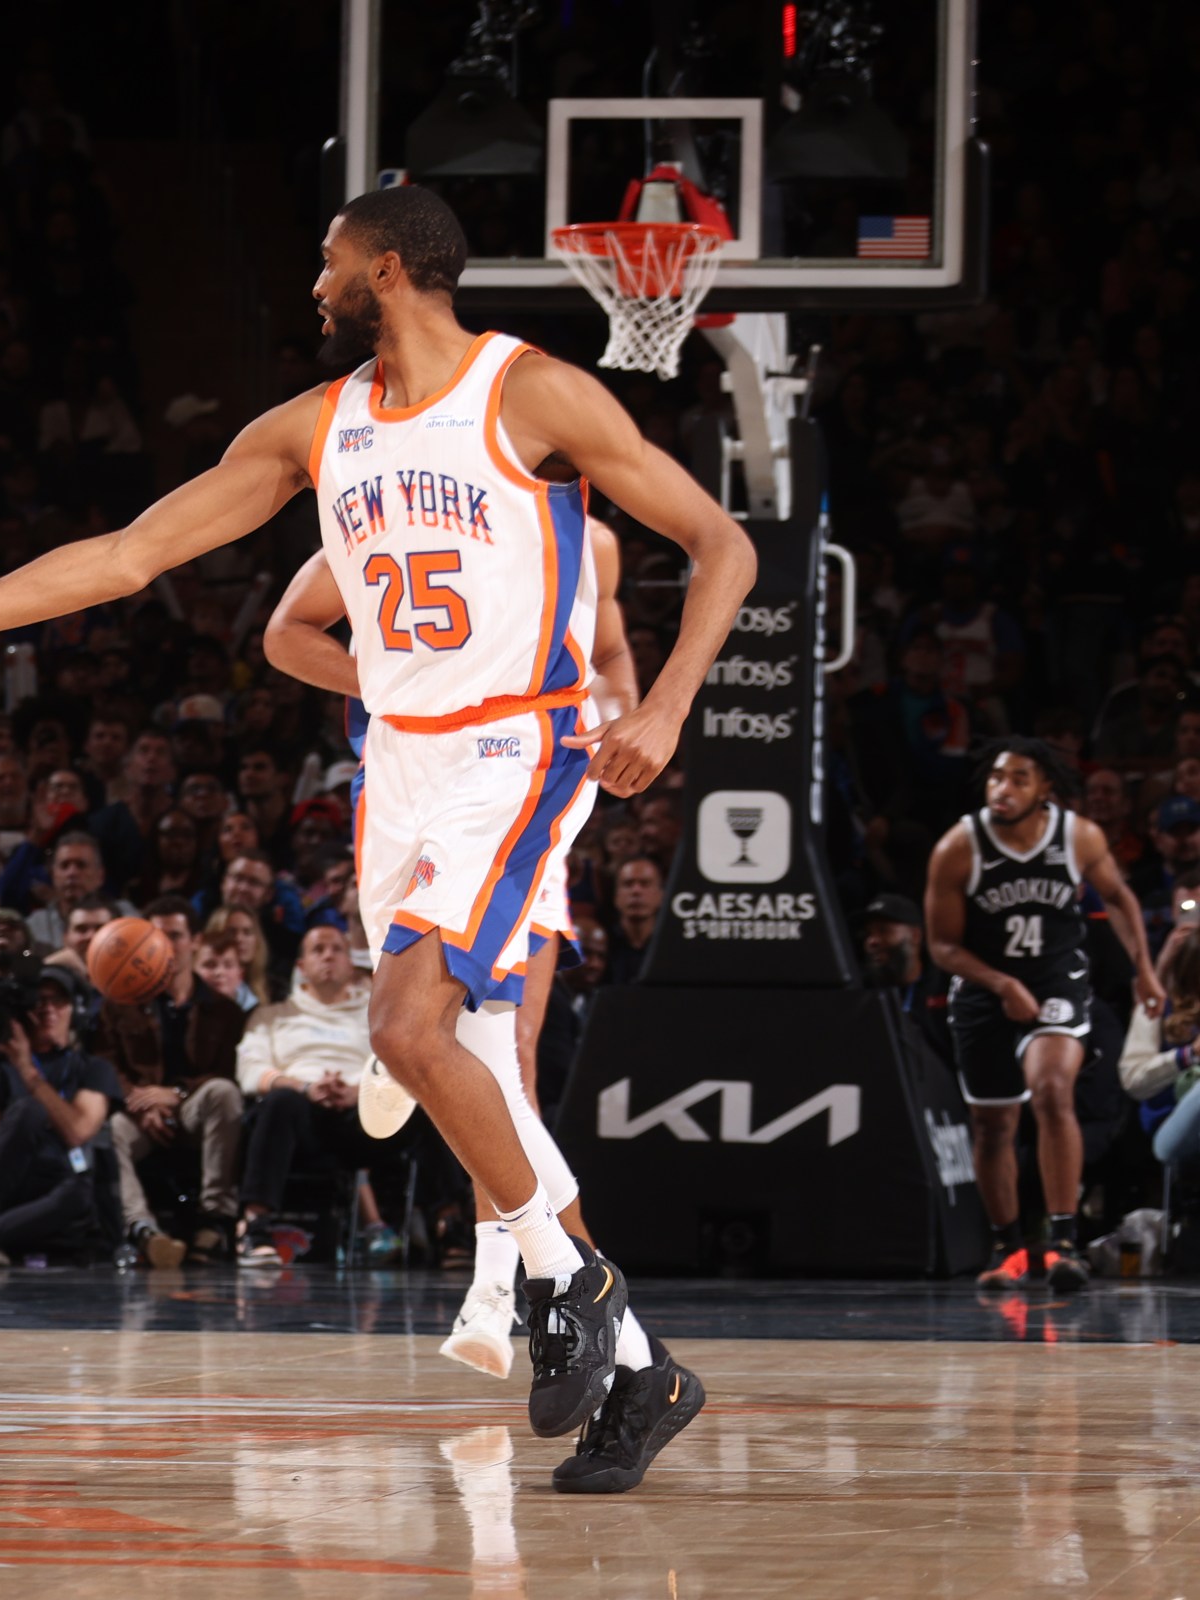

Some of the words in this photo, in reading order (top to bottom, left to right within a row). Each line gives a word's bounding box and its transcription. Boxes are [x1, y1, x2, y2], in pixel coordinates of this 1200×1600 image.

[338, 426, 374, 453] NYC
[332, 475, 386, 557] NEW
[396, 470, 494, 546] YORK
[362, 549, 472, 653] 25
[731, 605, 792, 637] osys
[703, 706, 792, 743] Infosys
[671, 891, 817, 920] CAESARS
[975, 877, 1074, 914] BROOKLYN
[1005, 914, 1044, 957] 24
